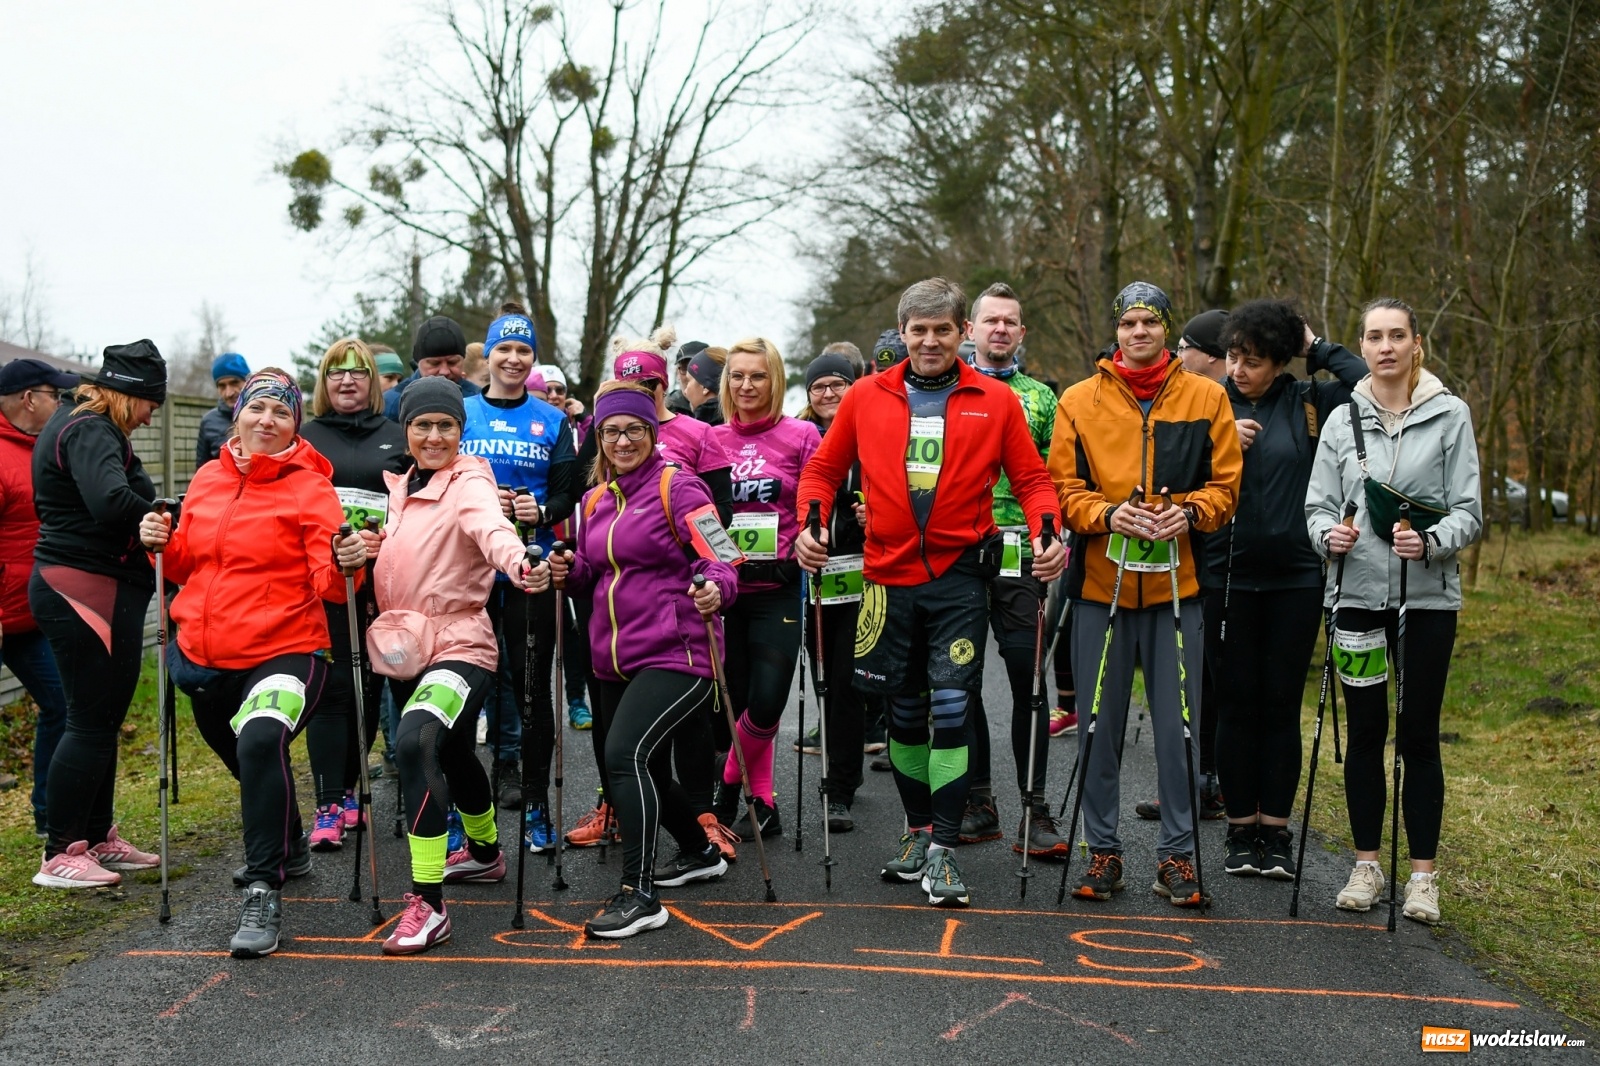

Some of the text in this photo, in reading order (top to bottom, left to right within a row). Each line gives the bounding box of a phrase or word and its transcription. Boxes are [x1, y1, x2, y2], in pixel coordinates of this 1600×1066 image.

[458, 438, 552, 462] RUNNERS
[905, 438, 941, 463] 10
[513, 459, 536, 468] TEAM
[731, 478, 774, 504] UPĘ
[730, 529, 760, 551] 19
[1137, 538, 1155, 561] 9
[834, 573, 849, 596] 5
[1339, 650, 1372, 677] 27
[246, 690, 282, 715] 11
[414, 684, 434, 703] 6
